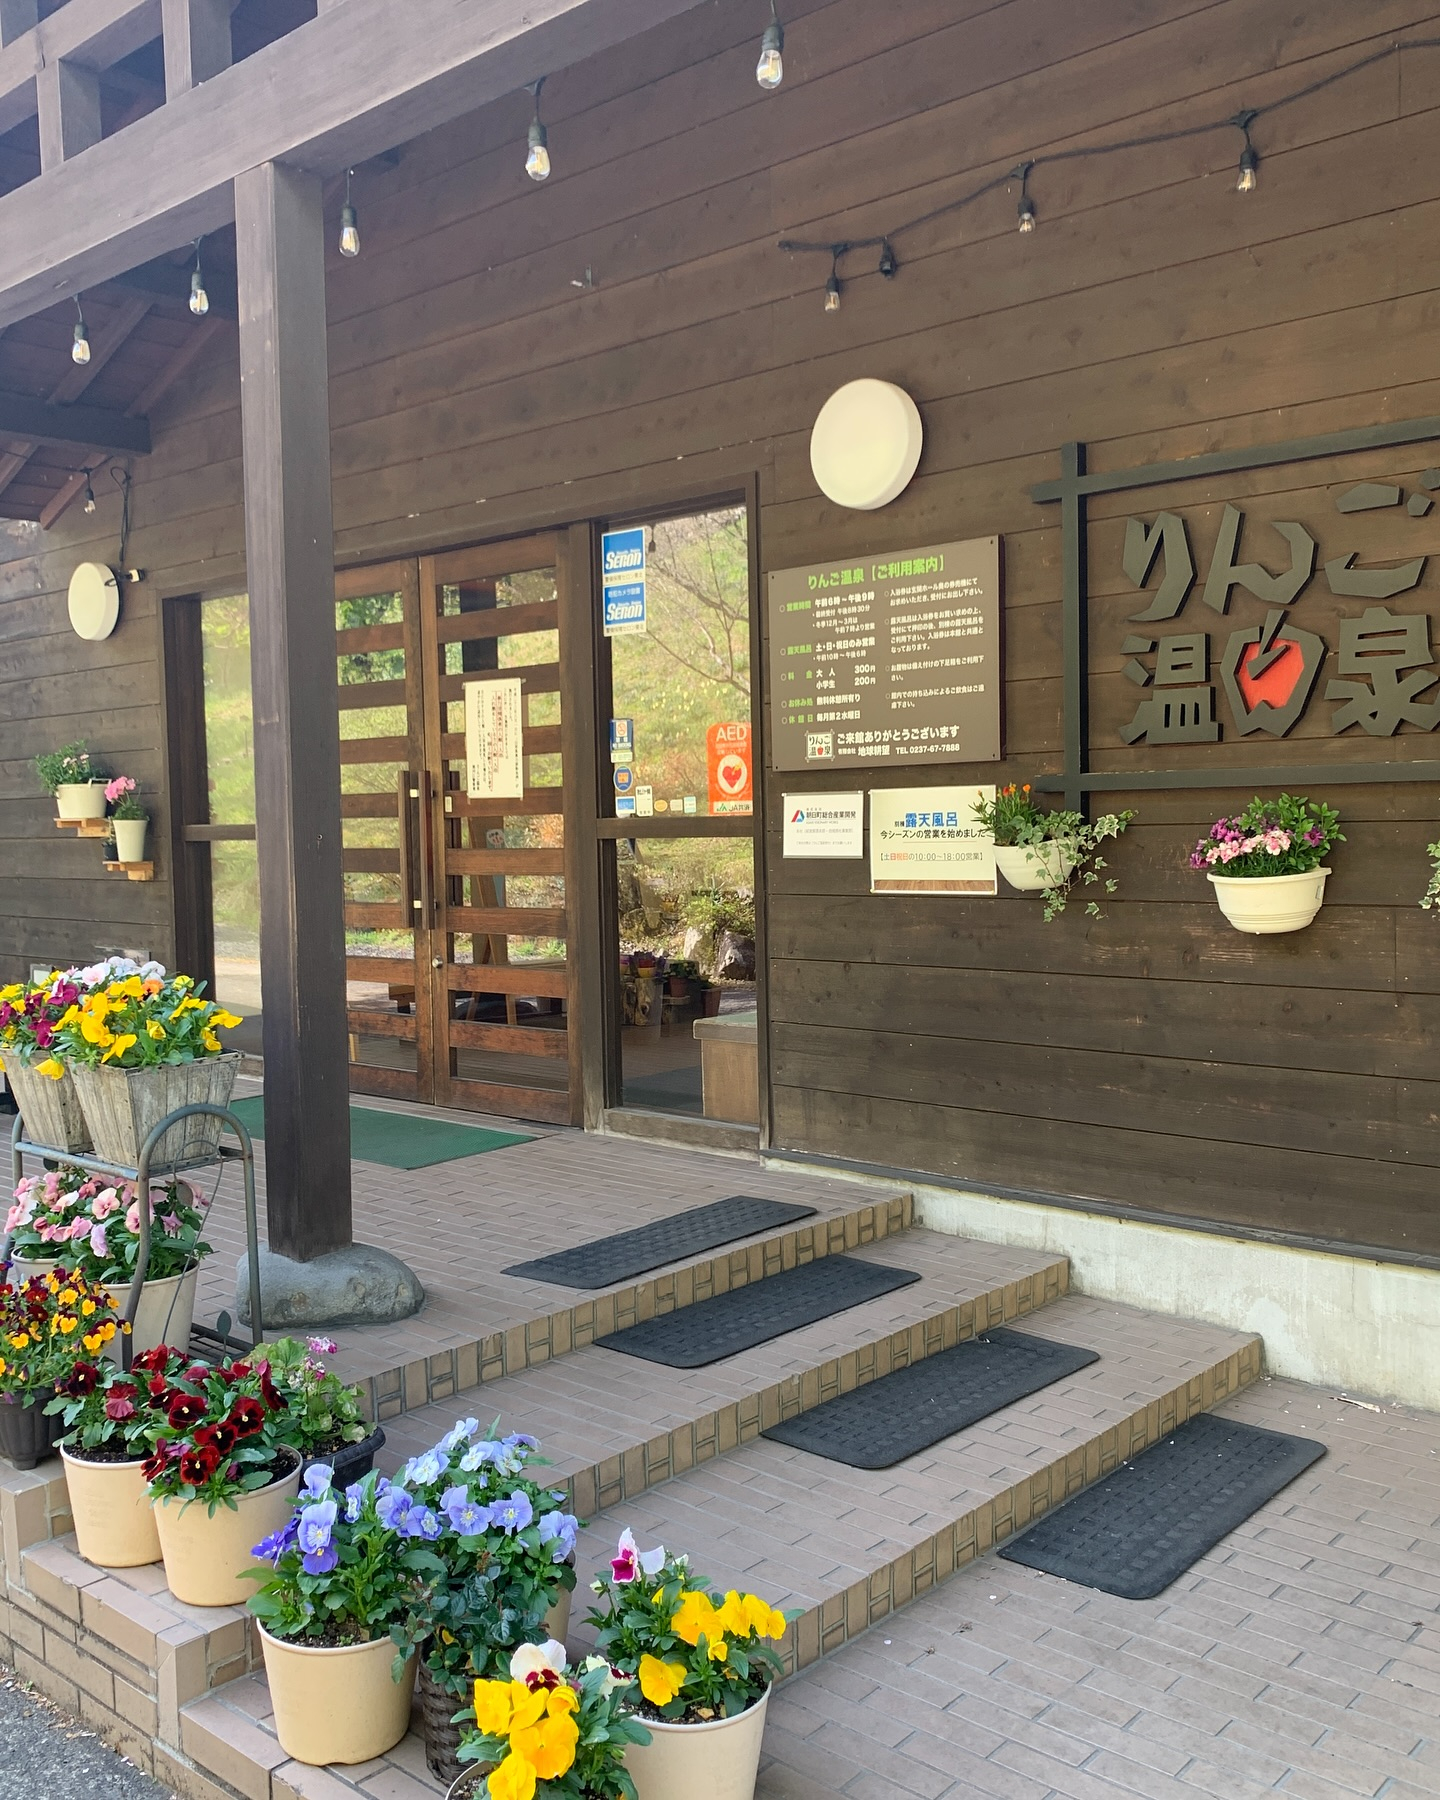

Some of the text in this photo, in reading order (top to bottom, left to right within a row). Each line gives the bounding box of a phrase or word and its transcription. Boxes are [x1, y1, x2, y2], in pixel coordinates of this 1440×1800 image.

[1121, 468, 1440, 622] りんご
[808, 567, 865, 590] りんご温泉
[834, 622, 876, 635] 午前7時より営業
[787, 636, 876, 656] 露天風呂 土・日・祝日のみ営業
[891, 643, 931, 653] なっております。
[854, 664, 876, 674] 300円
[815, 676, 876, 690] 小学生 200円
[788, 693, 861, 708] お休み処 無料休憩所有り
[816, 710, 861, 722] 毎月第2水曜日
[716, 725, 747, 742] AED
[837, 724, 960, 745] ご来館ありがとうございます
[808, 735, 831, 746] りんご
[895, 746, 909, 755] TEL
[806, 810, 857, 819] 朝日町総合産業開発
[879, 828, 986, 840] 今シーズンの営業を始めました
